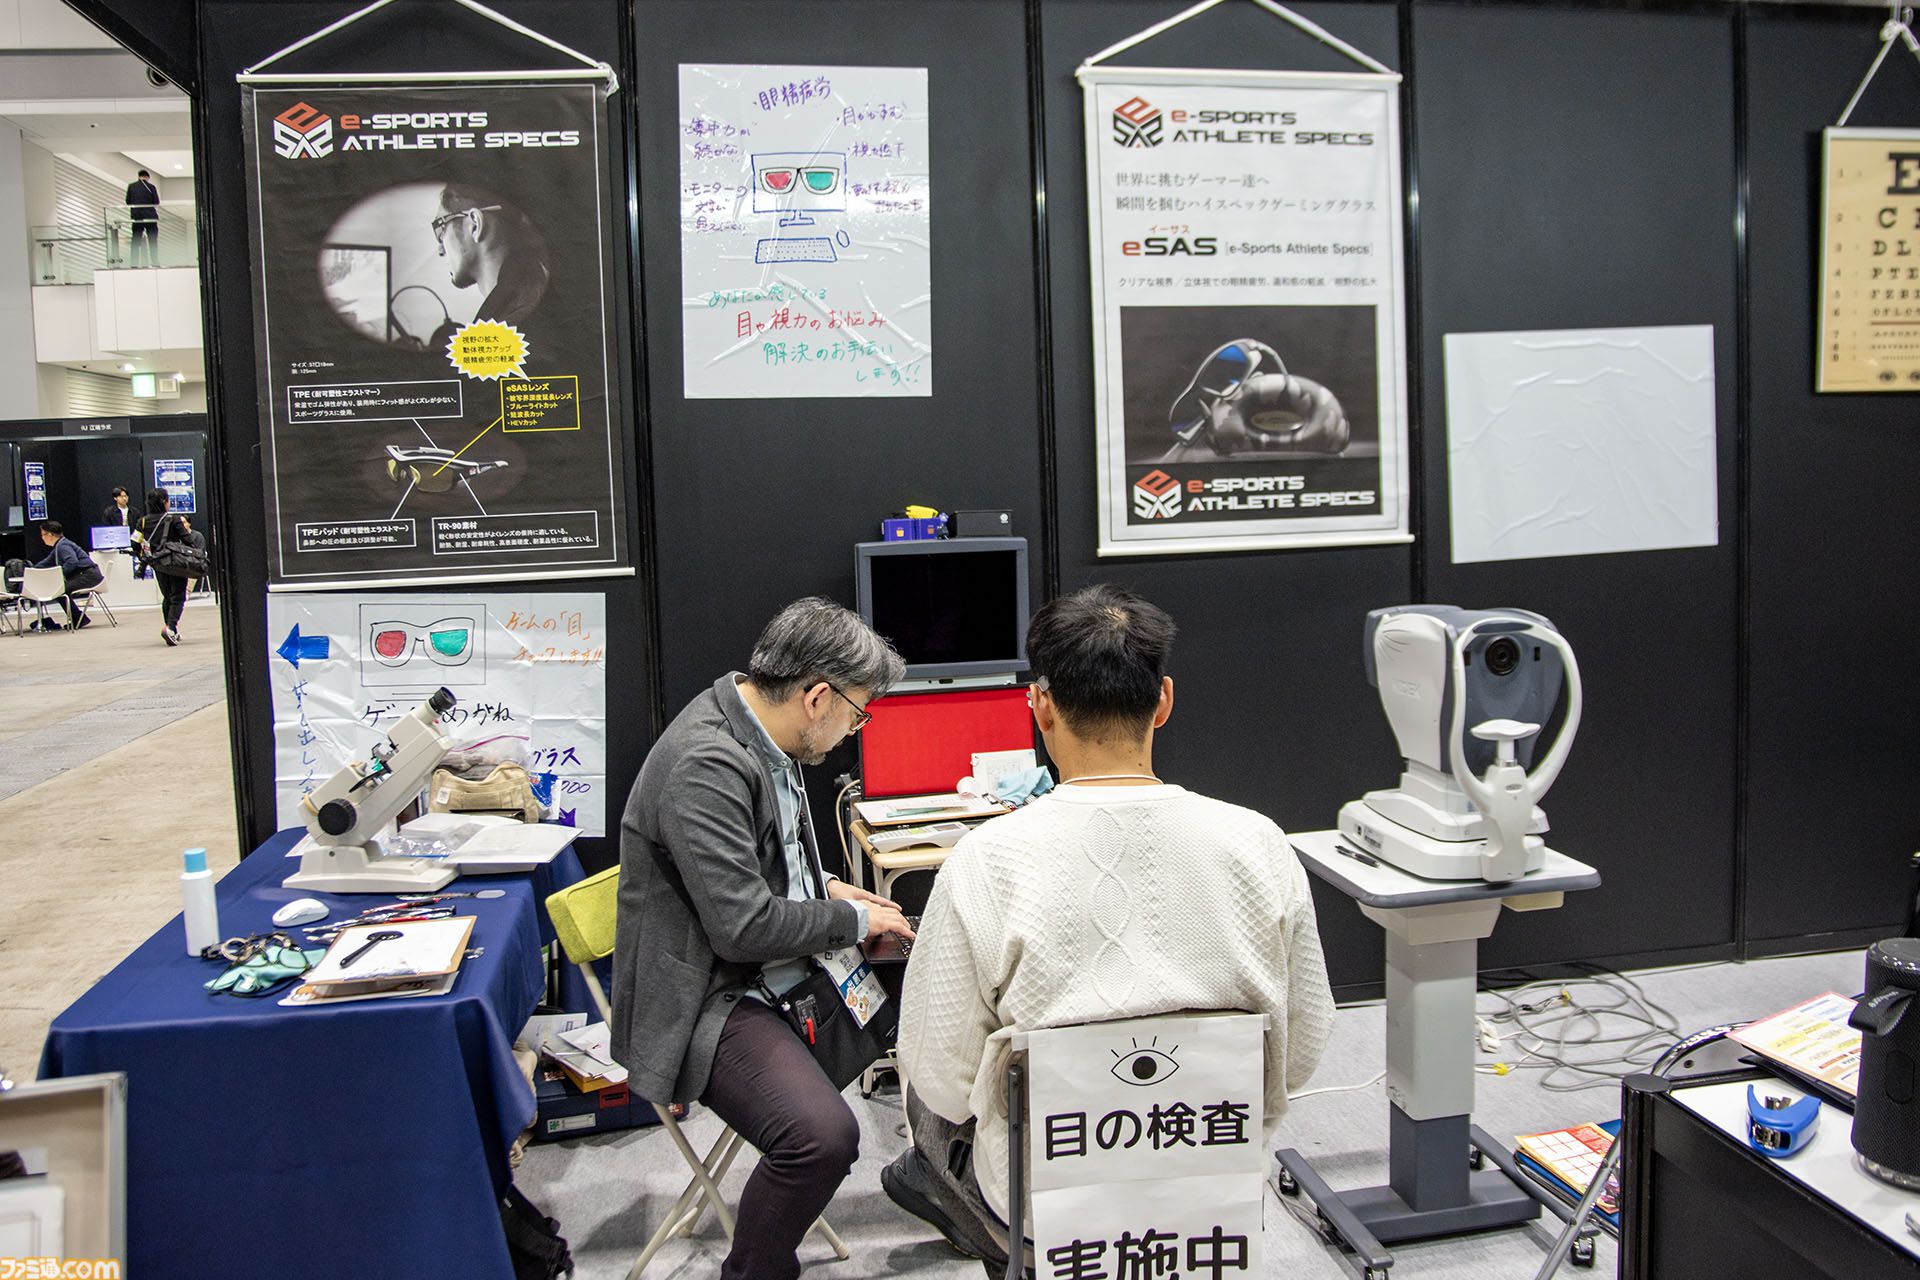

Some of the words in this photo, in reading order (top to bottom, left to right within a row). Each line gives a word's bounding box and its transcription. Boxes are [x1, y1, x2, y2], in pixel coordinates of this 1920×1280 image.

[340, 112, 488, 130] e-SPORTS
[1171, 110, 1297, 125] e-SPORTS
[342, 133, 476, 151] ATHLETE
[484, 131, 580, 148] SPECS
[1173, 129, 1286, 144] ATHLETE
[1295, 132, 1374, 146] SPECS
[1878, 206, 1898, 229] C
[1122, 237, 1218, 257] eSAS
[1286, 242, 1329, 255] Athlete
[1187, 476, 1305, 493] e-SPORTS
[1187, 494, 1295, 512] ATHLETE
[1299, 491, 1376, 508] SPECS
[1045, 1100, 1250, 1161] 目の検査
[1046, 1225, 1249, 1280] 実施中
